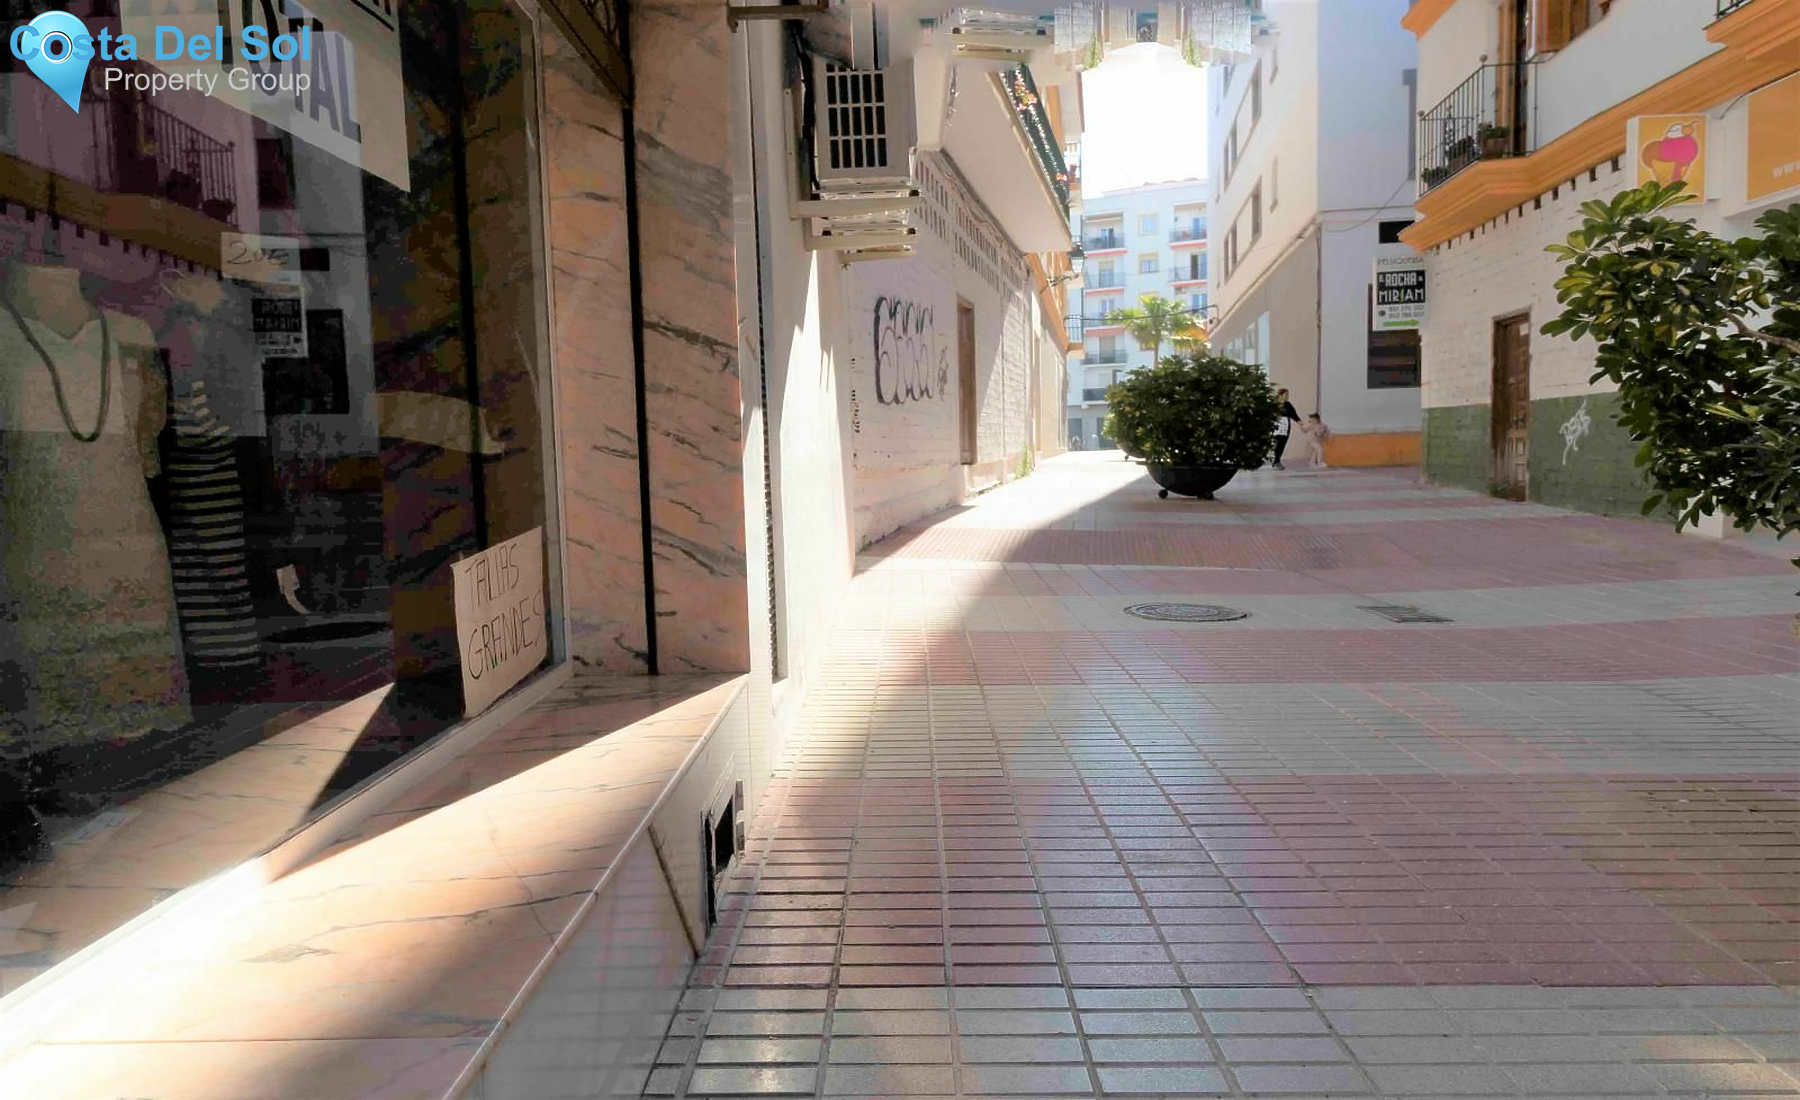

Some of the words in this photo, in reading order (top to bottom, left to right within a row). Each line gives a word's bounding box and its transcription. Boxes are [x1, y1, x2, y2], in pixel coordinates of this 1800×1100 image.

[1378, 288, 1424, 303] MIRIAM
[1385, 272, 1416, 286] ROCHA
[465, 543, 520, 612] TALLAS
[467, 590, 541, 680] GRANDES
